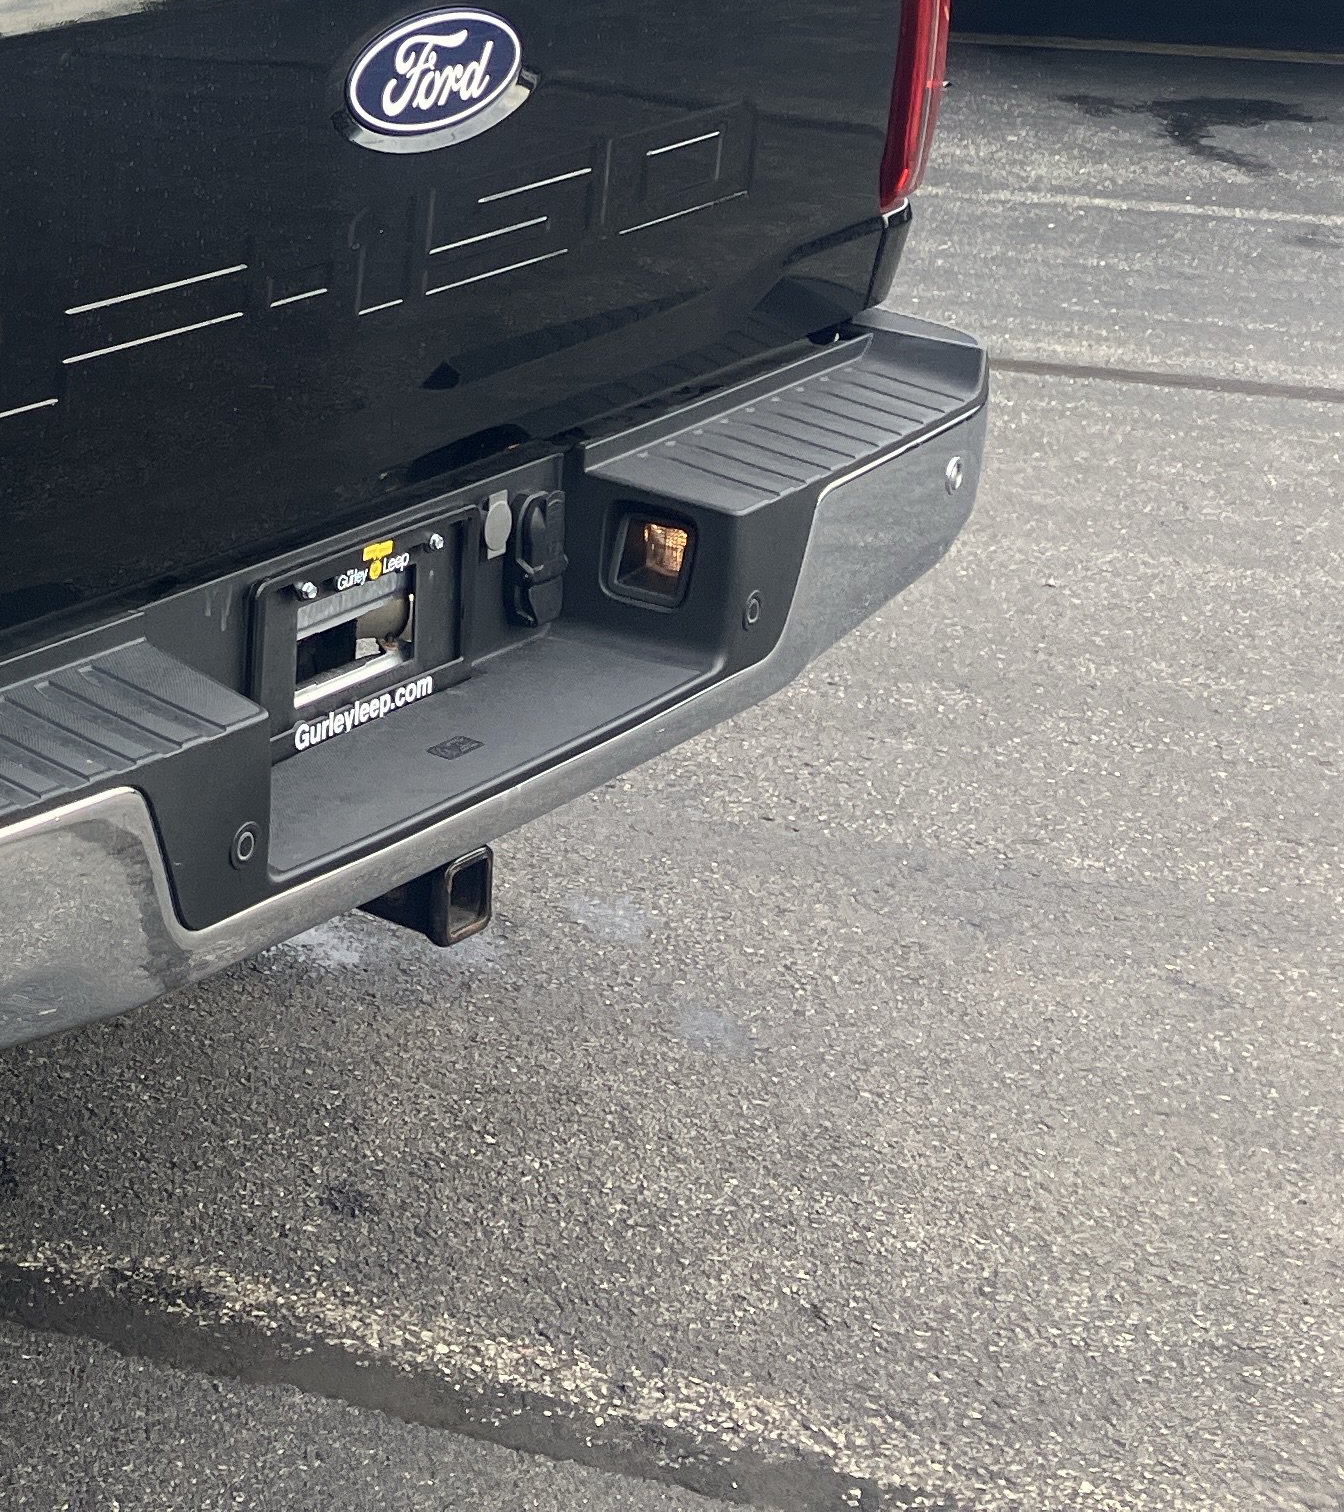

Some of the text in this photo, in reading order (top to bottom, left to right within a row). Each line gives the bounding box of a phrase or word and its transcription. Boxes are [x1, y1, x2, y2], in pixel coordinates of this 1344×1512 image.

[381, 29, 494, 117] Ford
[382, 552, 410, 575] Leep
[294, 675, 433, 751] Gurleyleep.com
